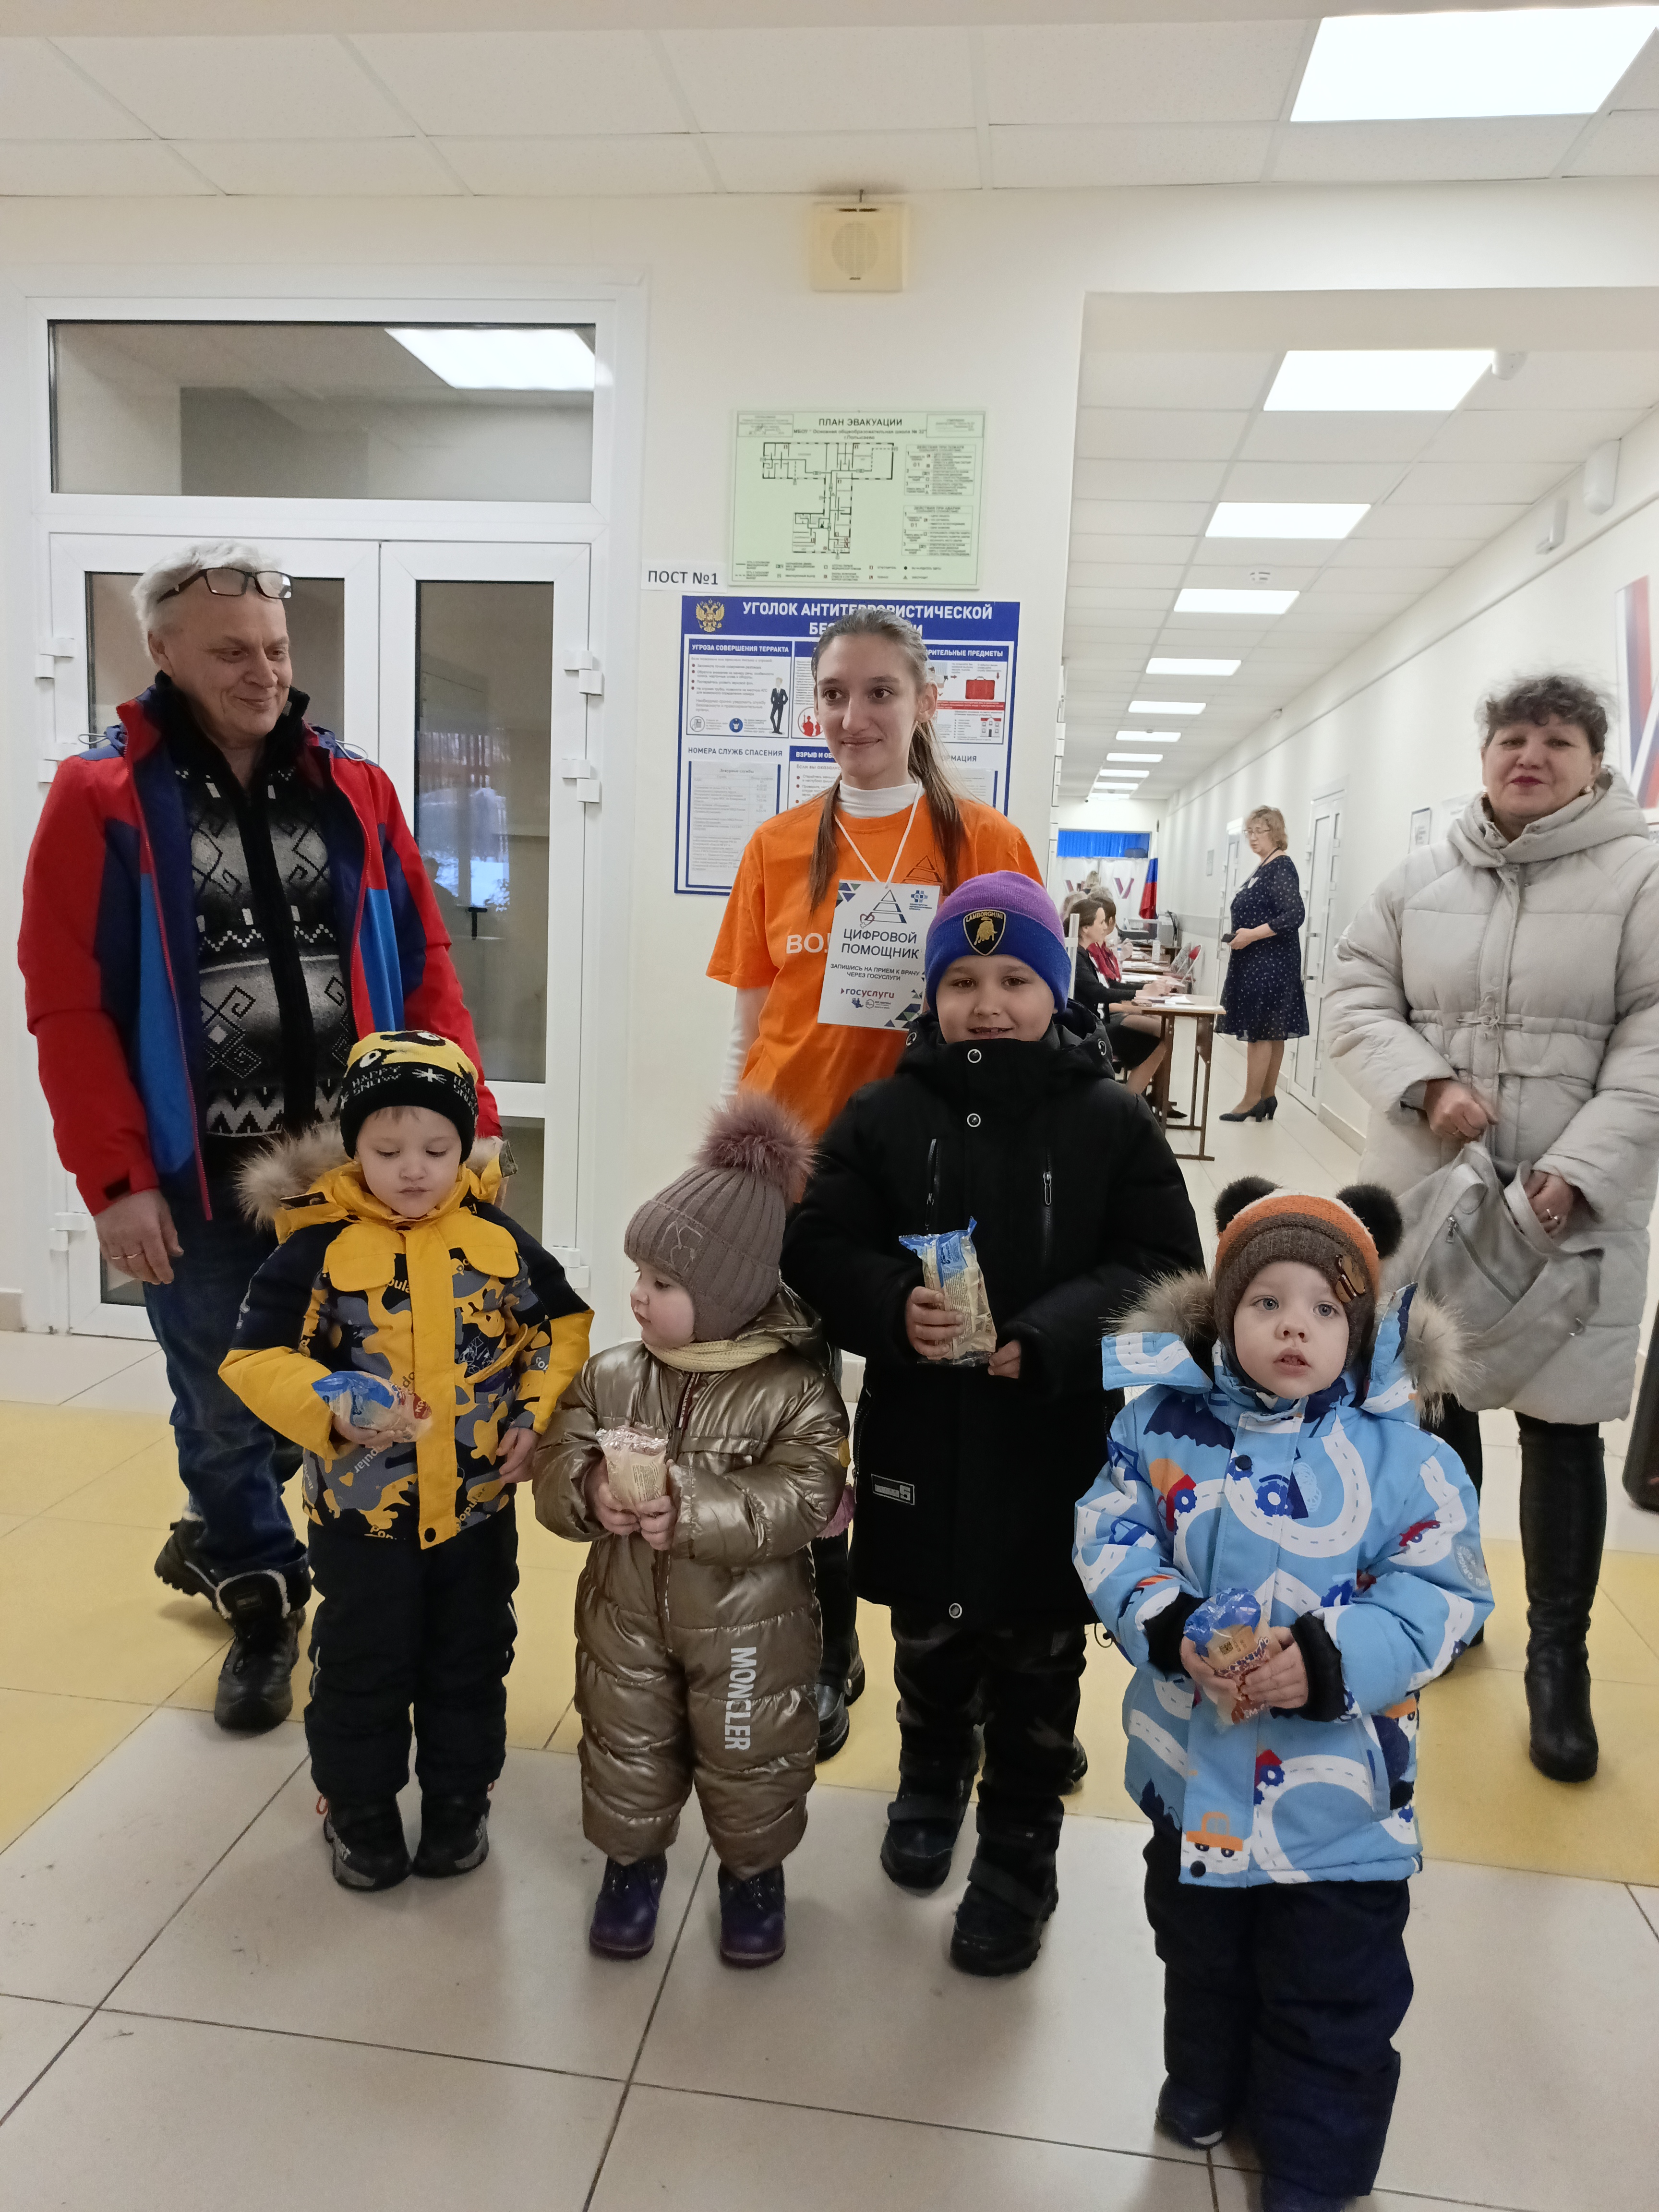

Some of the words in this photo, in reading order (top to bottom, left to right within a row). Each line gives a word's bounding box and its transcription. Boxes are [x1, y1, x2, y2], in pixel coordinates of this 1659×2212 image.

[818, 418, 844, 426] ПЛАН
[847, 418, 902, 427] ЭВАКУАЦИИ
[648, 570, 688, 584] ПОСТ
[693, 572, 718, 585] №1
[743, 602, 798, 616] УГОЛОК
[801, 603, 992, 620] АНТИТЕИСТИЧЕСКОЙ
[966, 912, 1003, 922] LAMBORGHINI
[843, 928, 917, 944] ЦИФРОВОЙ
[841, 943, 920, 959] ПОМОЩНИК
[845, 988, 895, 999] госуслуги
[352, 1065, 401, 1089] HAPPY
[353, 1073, 401, 1096] SNOW
[725, 1647, 757, 1750] MONCLER
